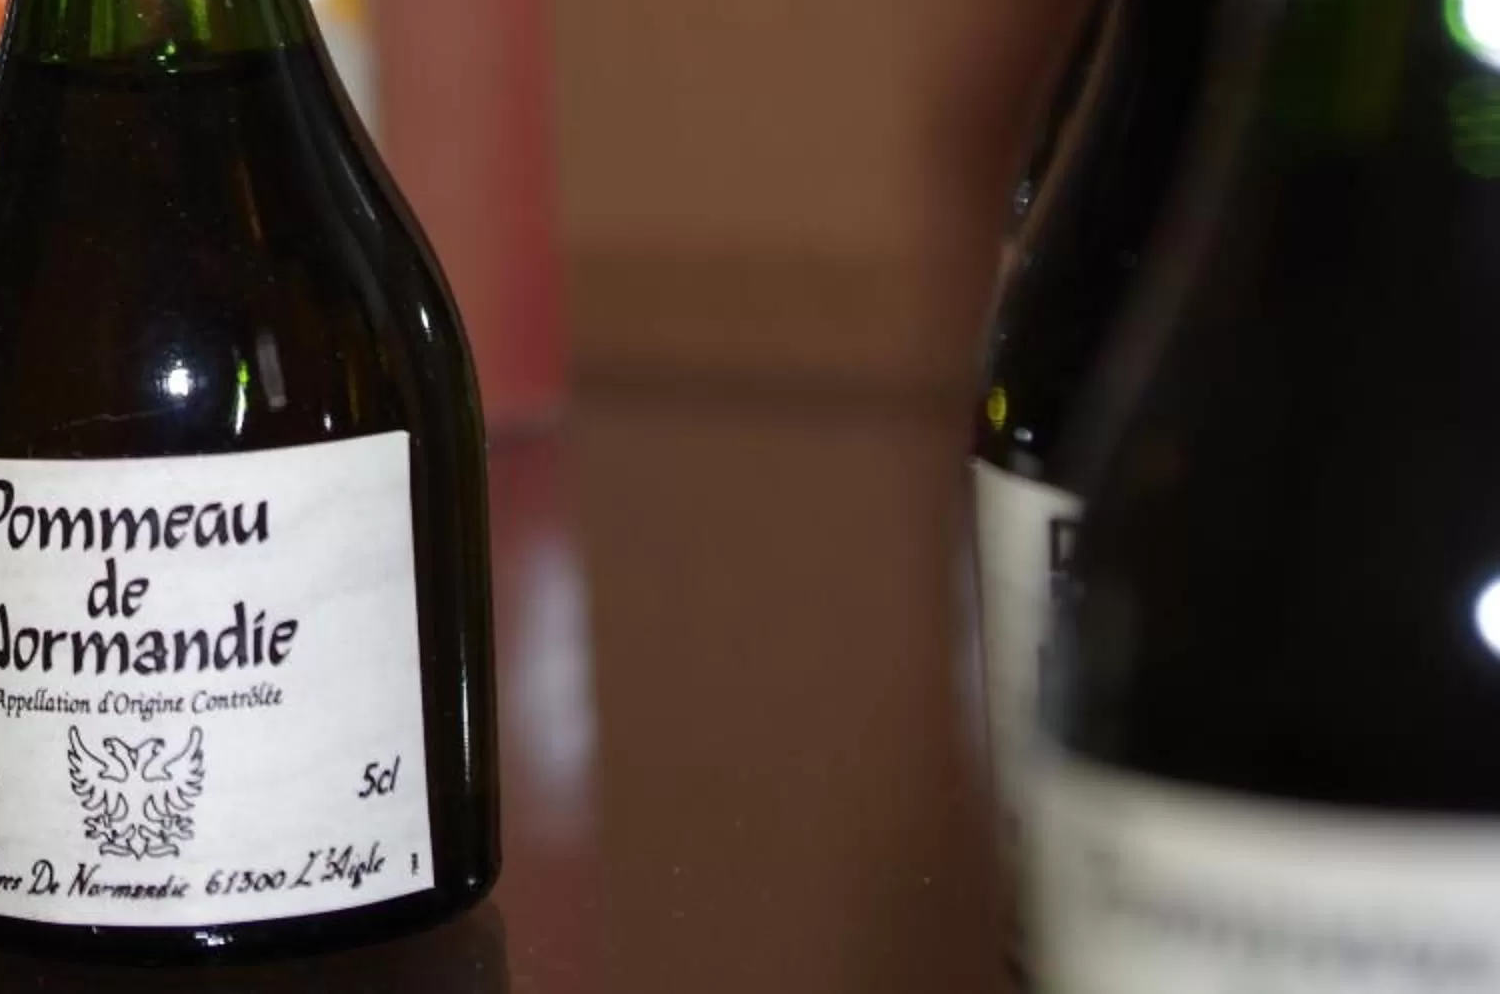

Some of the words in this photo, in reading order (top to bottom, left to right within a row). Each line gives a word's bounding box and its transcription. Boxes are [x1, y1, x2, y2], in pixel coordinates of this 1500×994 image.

[87, 557, 149, 619] de
[97, 690, 184, 722] d'Origine
[191, 681, 284, 713] Contrôlée
[358, 754, 402, 798] 5cl
[67, 862, 191, 899] Normandie
[205, 868, 286, 896] 61300
